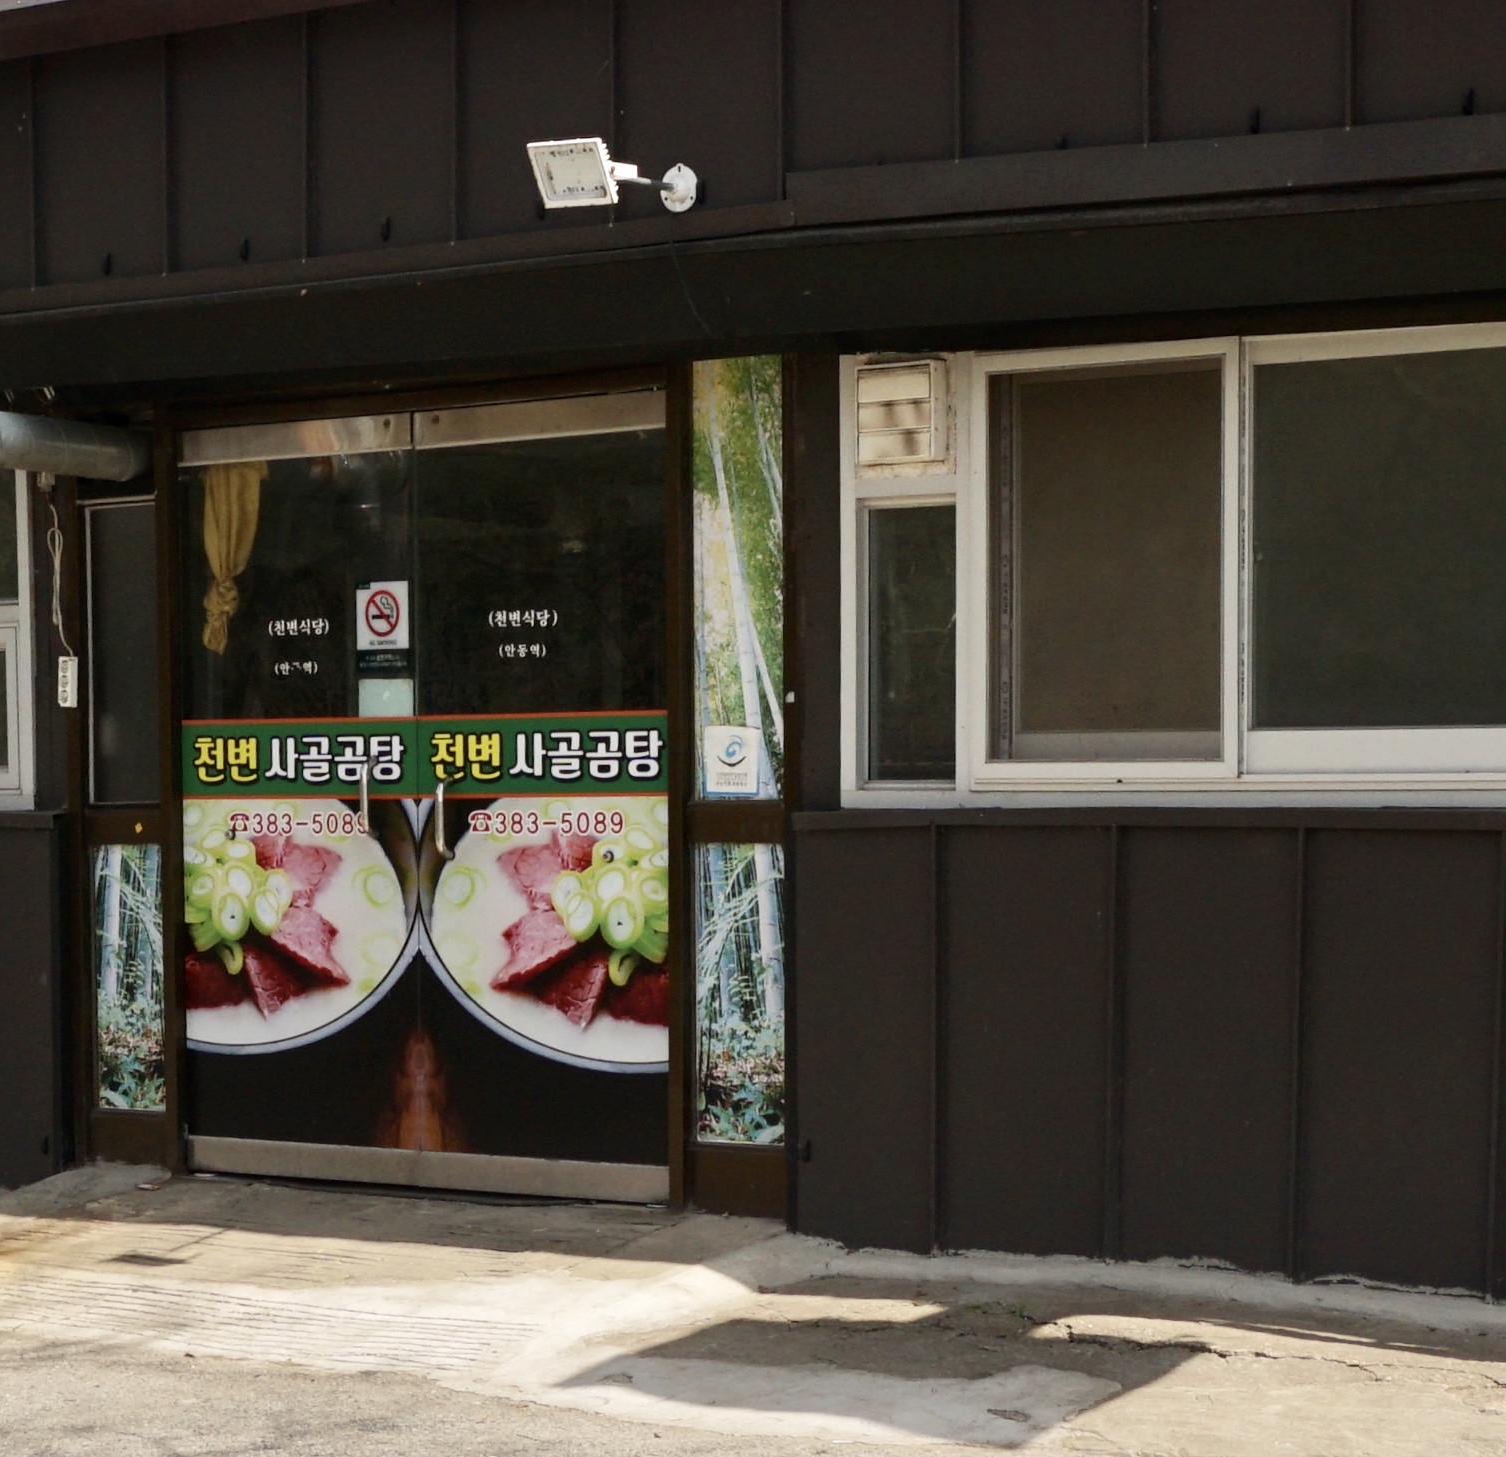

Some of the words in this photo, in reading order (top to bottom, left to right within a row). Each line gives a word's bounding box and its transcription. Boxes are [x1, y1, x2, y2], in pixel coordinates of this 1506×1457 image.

[274, 660, 319, 677] (안역)
[194, 736, 258, 783] 천변
[264, 734, 405, 783] 사골곰탕
[431, 732, 501, 780] 천변
[509, 729, 663, 779] 사골곰탕
[494, 811, 625, 834] 383-5089
